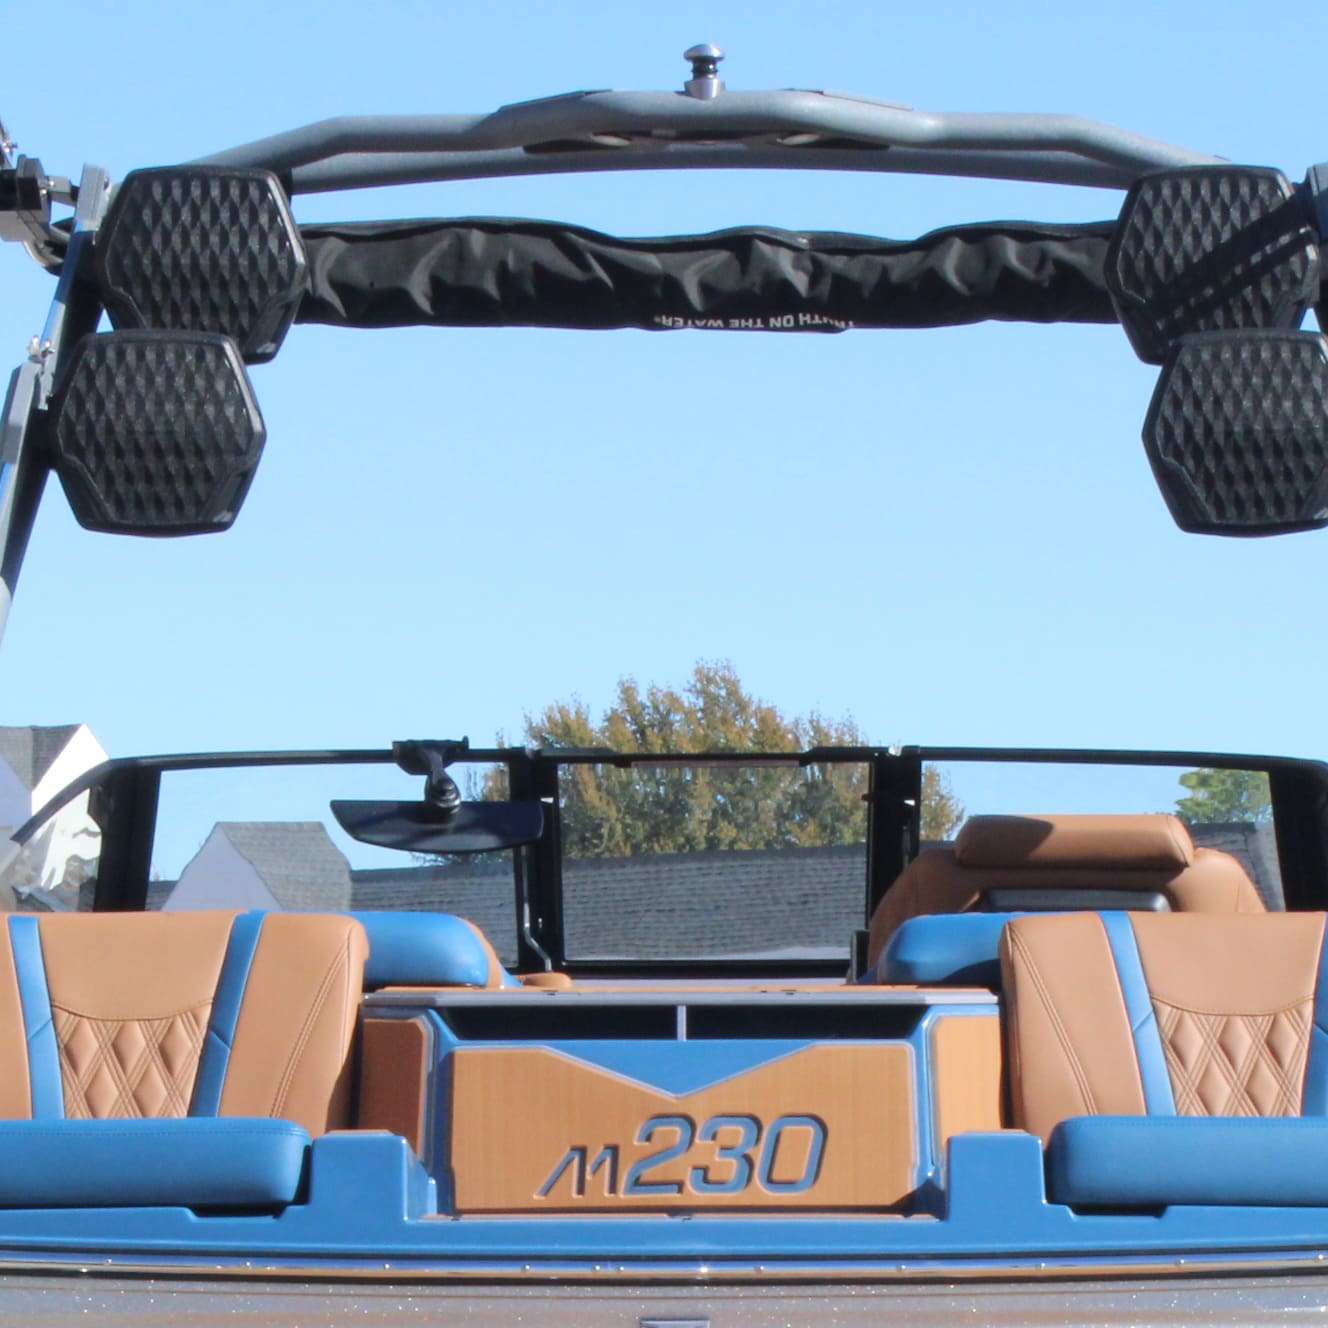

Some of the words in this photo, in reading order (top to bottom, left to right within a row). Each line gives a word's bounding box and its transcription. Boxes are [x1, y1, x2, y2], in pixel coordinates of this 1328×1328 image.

[662, 315, 724, 328] WATER
[728, 318, 762, 329] THE
[769, 315, 794, 328] ON
